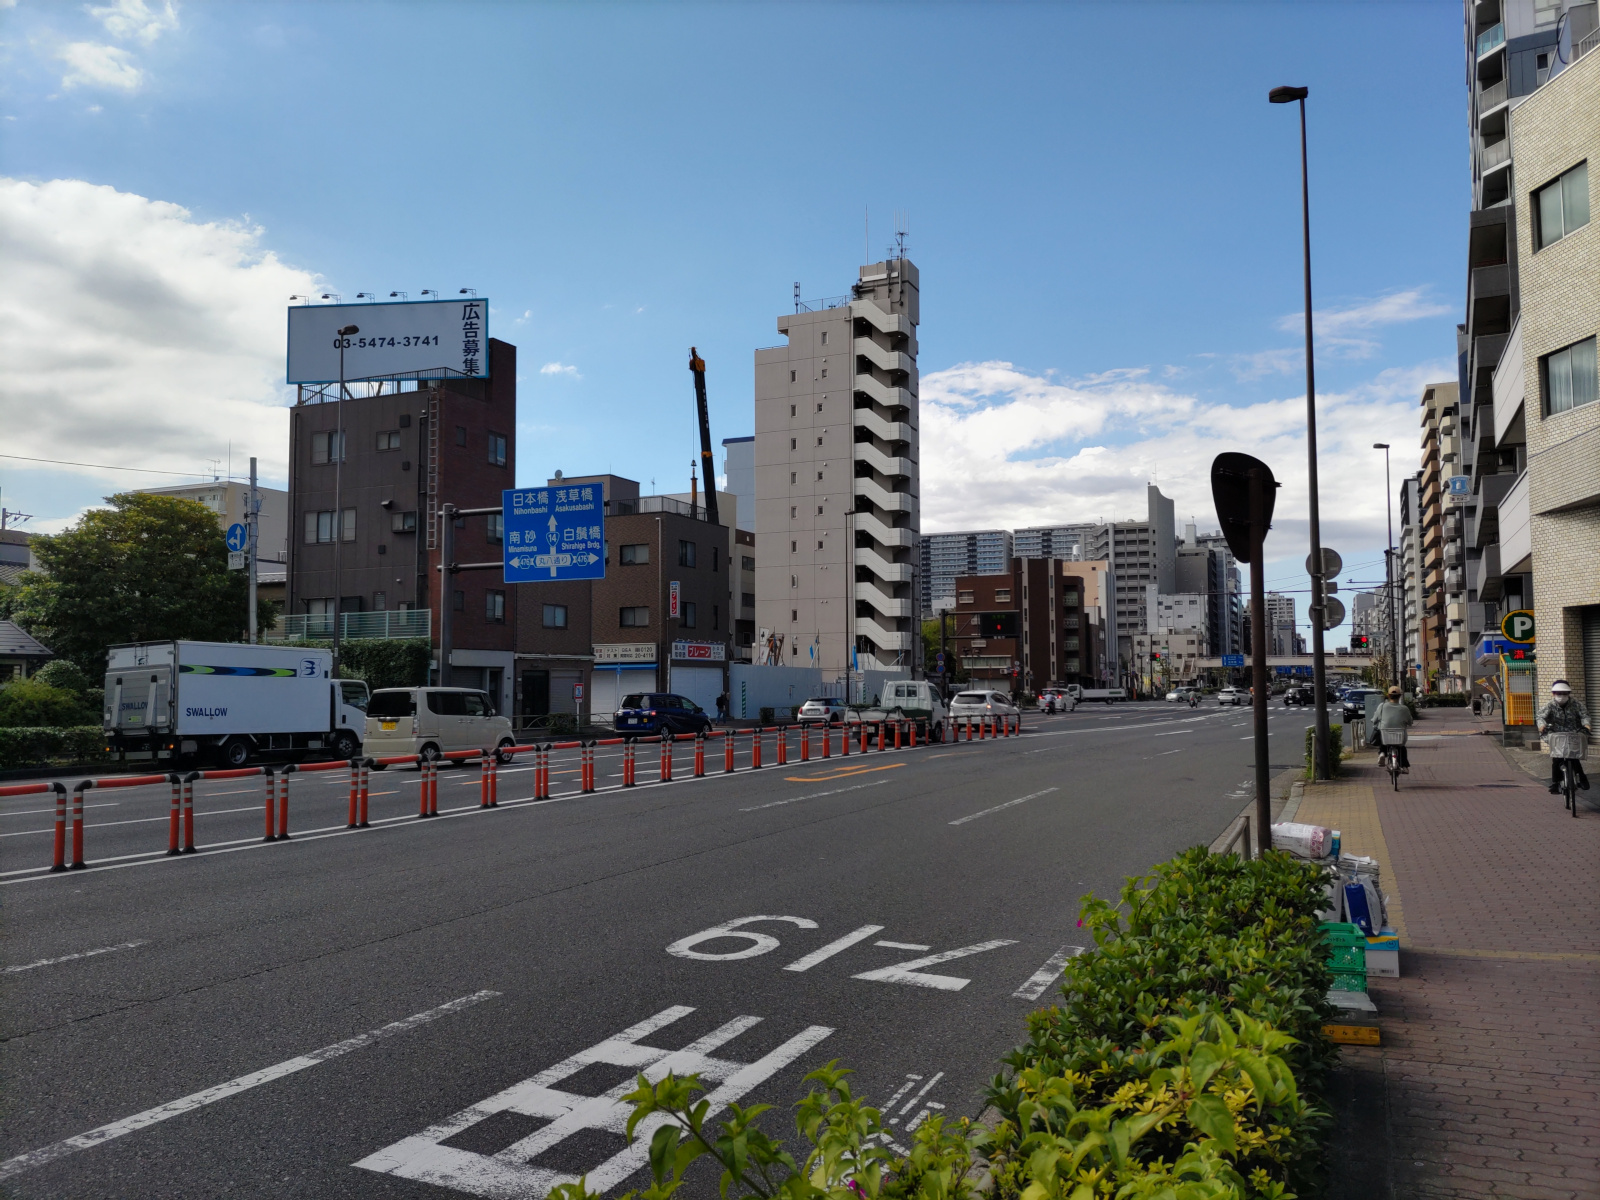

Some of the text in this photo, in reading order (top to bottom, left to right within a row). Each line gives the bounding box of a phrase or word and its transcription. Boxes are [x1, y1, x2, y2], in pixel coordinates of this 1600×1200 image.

[333, 336, 439, 349] 03-5474-3741
[461, 302, 480, 376] 広告募集
[513, 488, 593, 506] 日本橋 浅草橋
[514, 503, 594, 515] Nihonbashi Asakusabashi
[509, 530, 536, 544] 南砂
[548, 534, 557, 542] 14
[562, 543, 585, 551] Shirahige
[520, 558, 530, 566] 476
[1514, 617, 1532, 637] P
[1514, 650, 1524, 659] 満
[186, 707, 228, 716] SWALLOW
